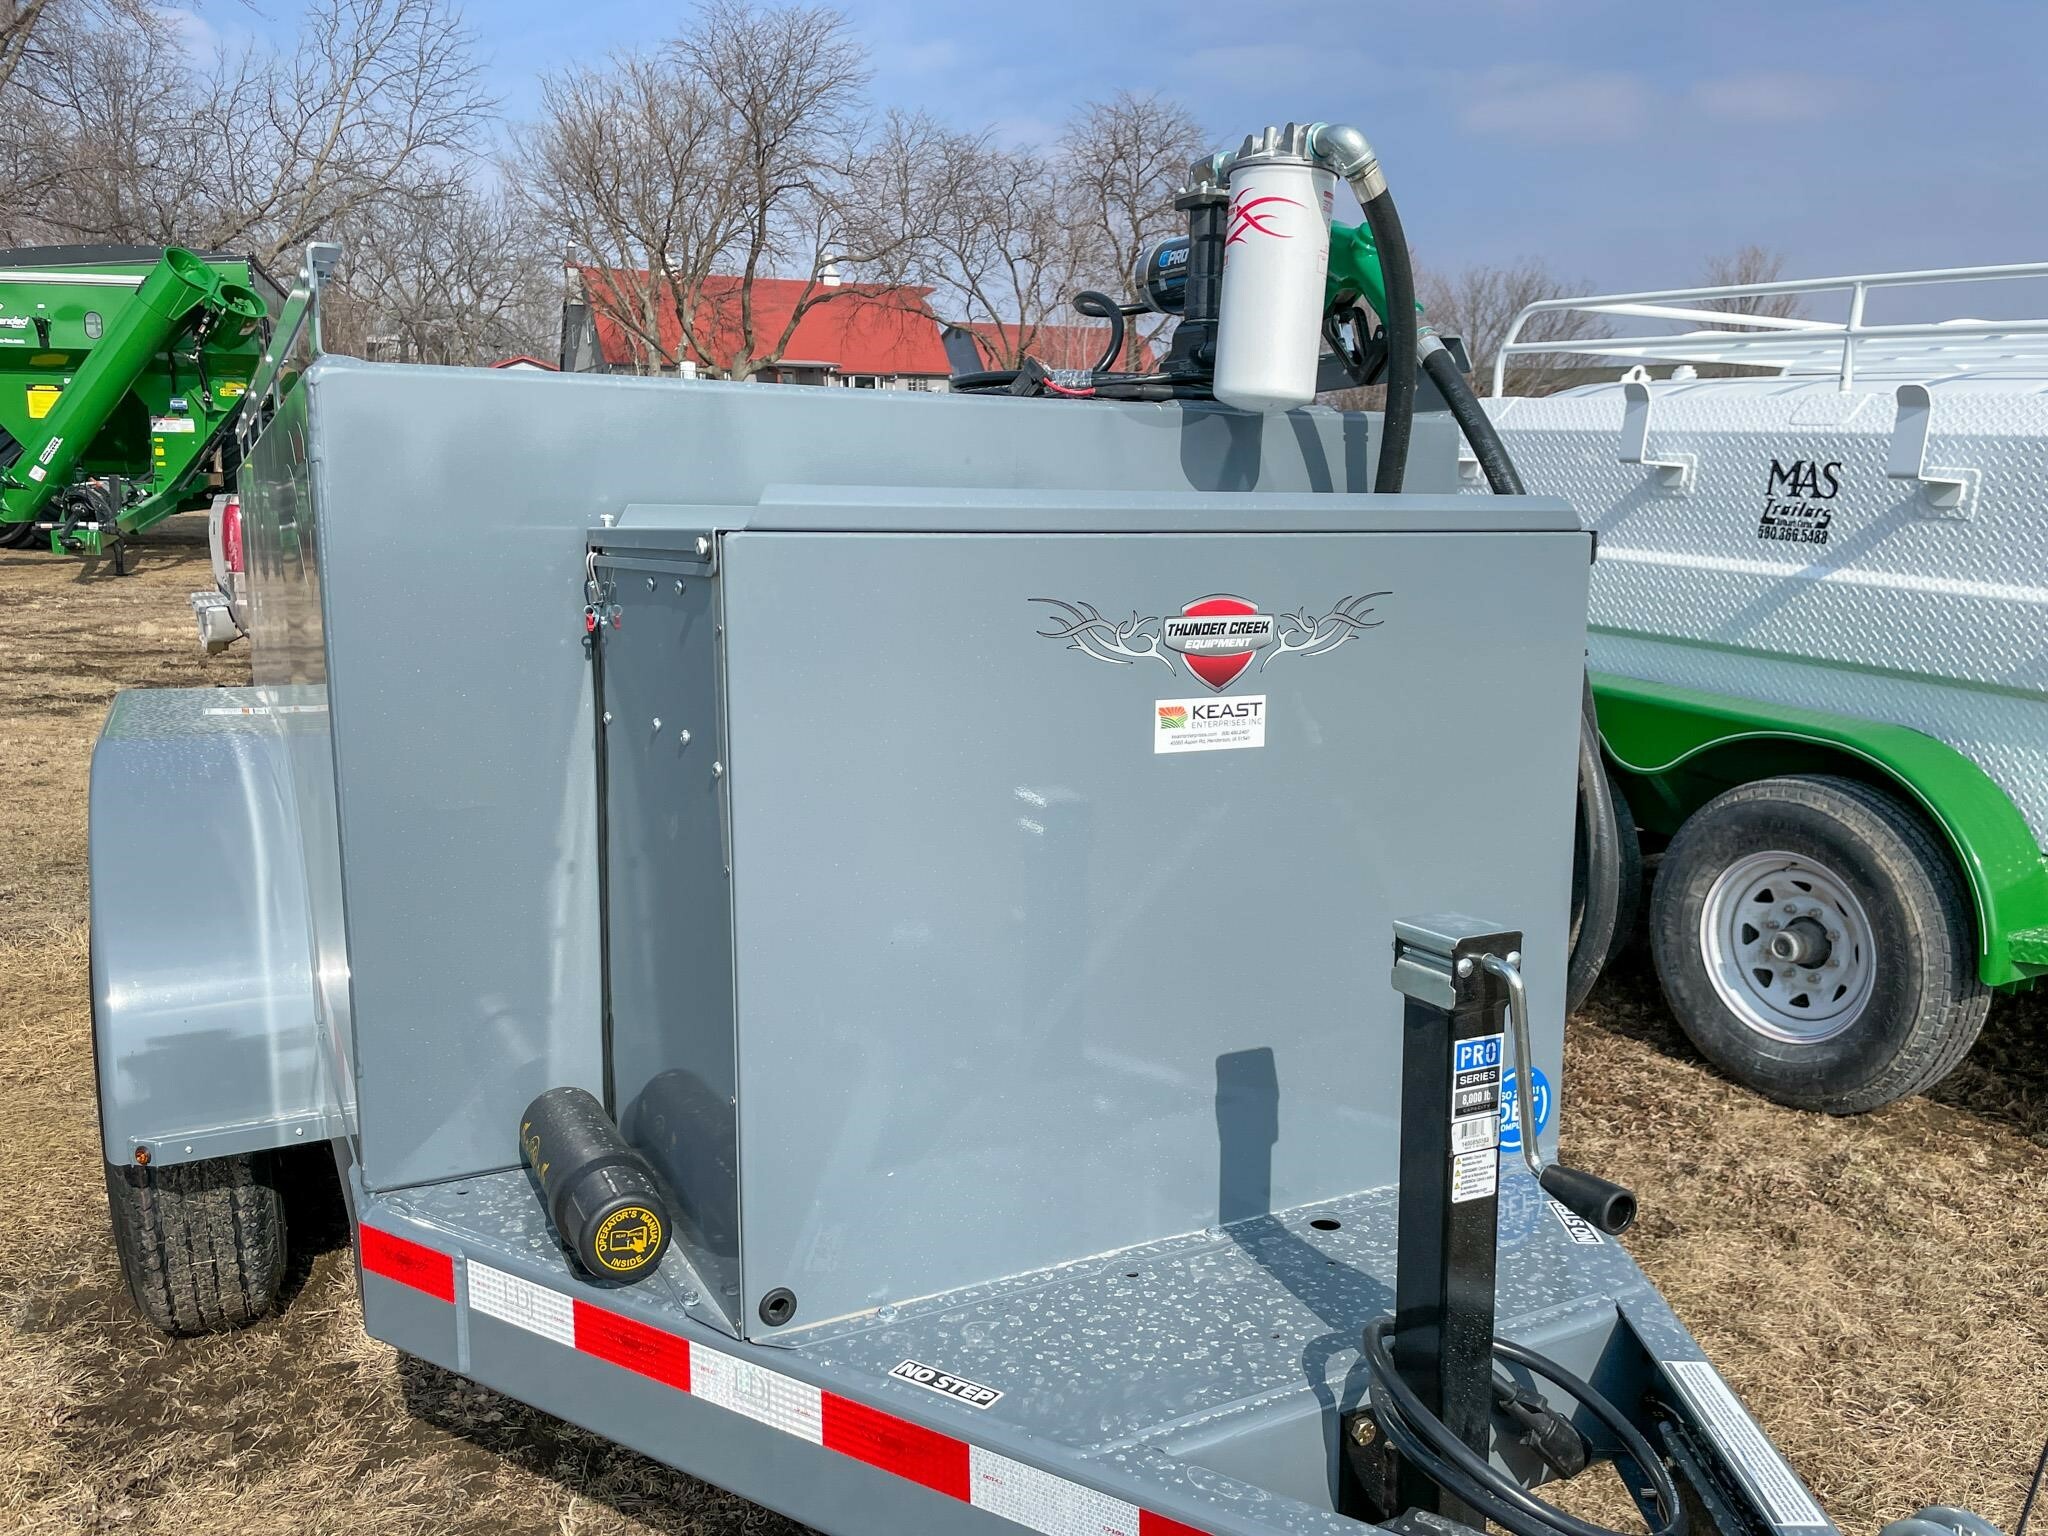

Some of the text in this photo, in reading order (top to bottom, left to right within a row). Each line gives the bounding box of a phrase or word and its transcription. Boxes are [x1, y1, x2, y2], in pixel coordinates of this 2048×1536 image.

[1765, 459, 1842, 499] MAS
[1760, 499, 1832, 529] Trailers
[1758, 526, 1828, 544] 580.366.5488
[1168, 620, 1271, 637] THUNDER CREEK
[1184, 637, 1253, 650] EQUIPMENT
[1192, 702, 1263, 720] KEAST
[1191, 717, 1263, 729] ENTERPRISES INC
[1460, 1041, 1497, 1069] PRO
[1460, 1070, 1496, 1086] SERIES
[1462, 1089, 1494, 1106] 8,000 lb.
[1462, 1104, 1491, 1113] CAPACITY
[599, 1210, 658, 1252] OPERATOR'S MANUAL
[1570, 1227, 1599, 1242] NO
[611, 1254, 643, 1267] INSIDE
[897, 1363, 995, 1403] NO STEP
